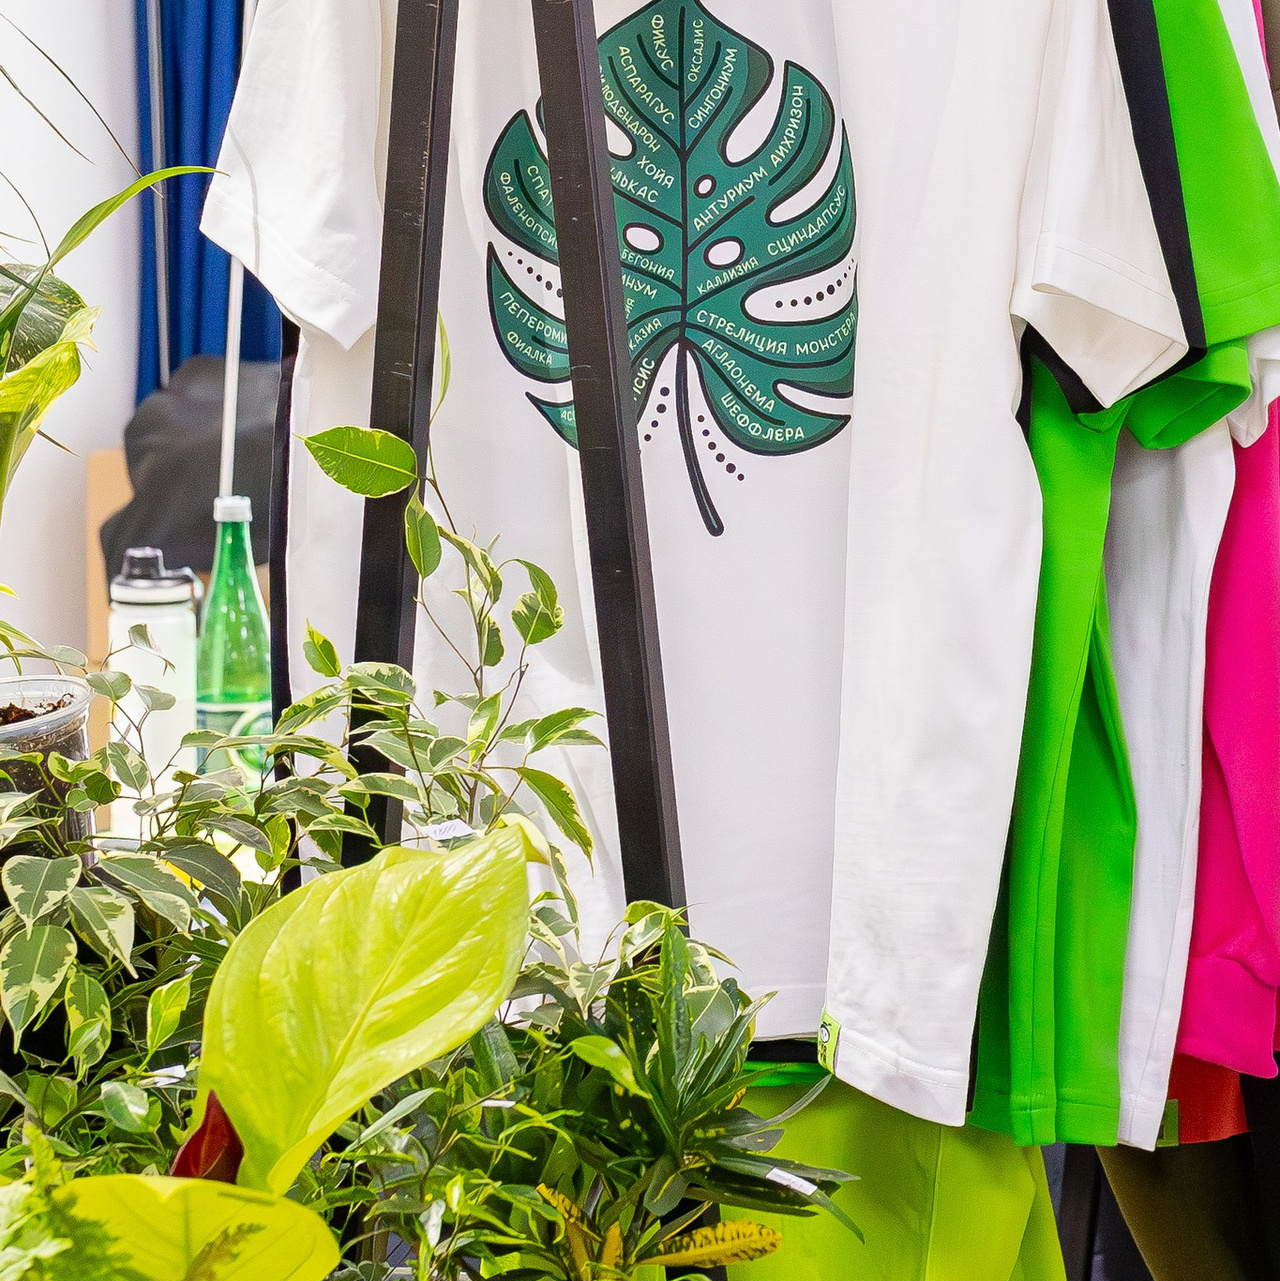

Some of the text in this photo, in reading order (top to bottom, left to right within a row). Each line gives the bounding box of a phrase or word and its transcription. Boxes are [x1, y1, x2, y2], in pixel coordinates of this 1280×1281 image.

[651, 14, 674, 71] ФИКУС
[687, 19, 704, 83] ОКСАЛИС
[599, 64, 661, 153] ЛОДЕНДРОН
[618, 46, 676, 125] АСПАРАГУС
[688, 48, 738, 129] СИНГОНИУМ
[610, 166, 659, 203] ЛЬКАС
[637, 155, 675, 189] ХОЙЯ
[693, 85, 803, 232] АНТУРИУМ АИХРИЗОН
[500, 172, 558, 249] ФАЛЕНОПСИ
[697, 184, 846, 295] КАЛЛИЗИЯ СЦИНДАПСУС
[621, 249, 675, 281] БЕГОНИЯ
[507, 331, 553, 366] ФИАЛКА
[697, 310, 856, 355] СТРЕЛИЦИЯ МОНСТЕРА
[701, 339, 775, 413] АГЛАОНЕМА
[720, 392, 805, 442] ШЕФФЛЕРА
